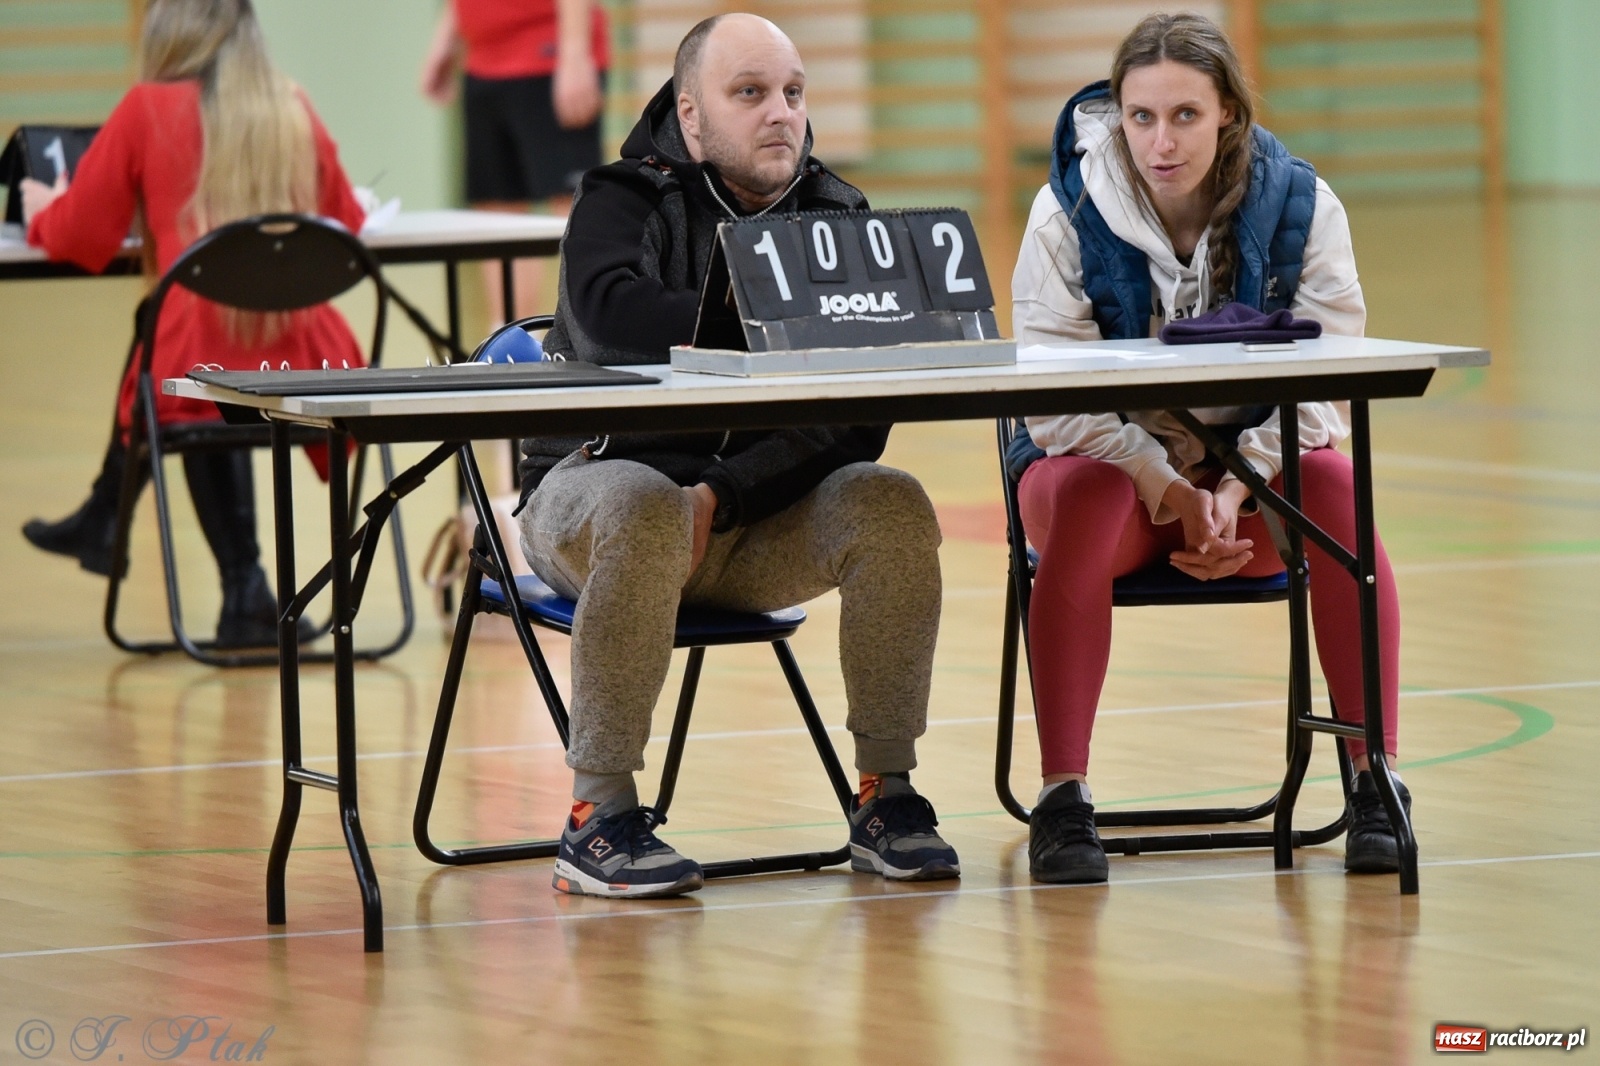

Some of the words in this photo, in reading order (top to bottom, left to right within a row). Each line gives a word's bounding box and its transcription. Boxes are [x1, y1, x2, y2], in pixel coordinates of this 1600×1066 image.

[753, 230, 793, 301] 1
[811, 220, 838, 271] 0
[865, 218, 895, 269] 0
[931, 222, 976, 293] 2
